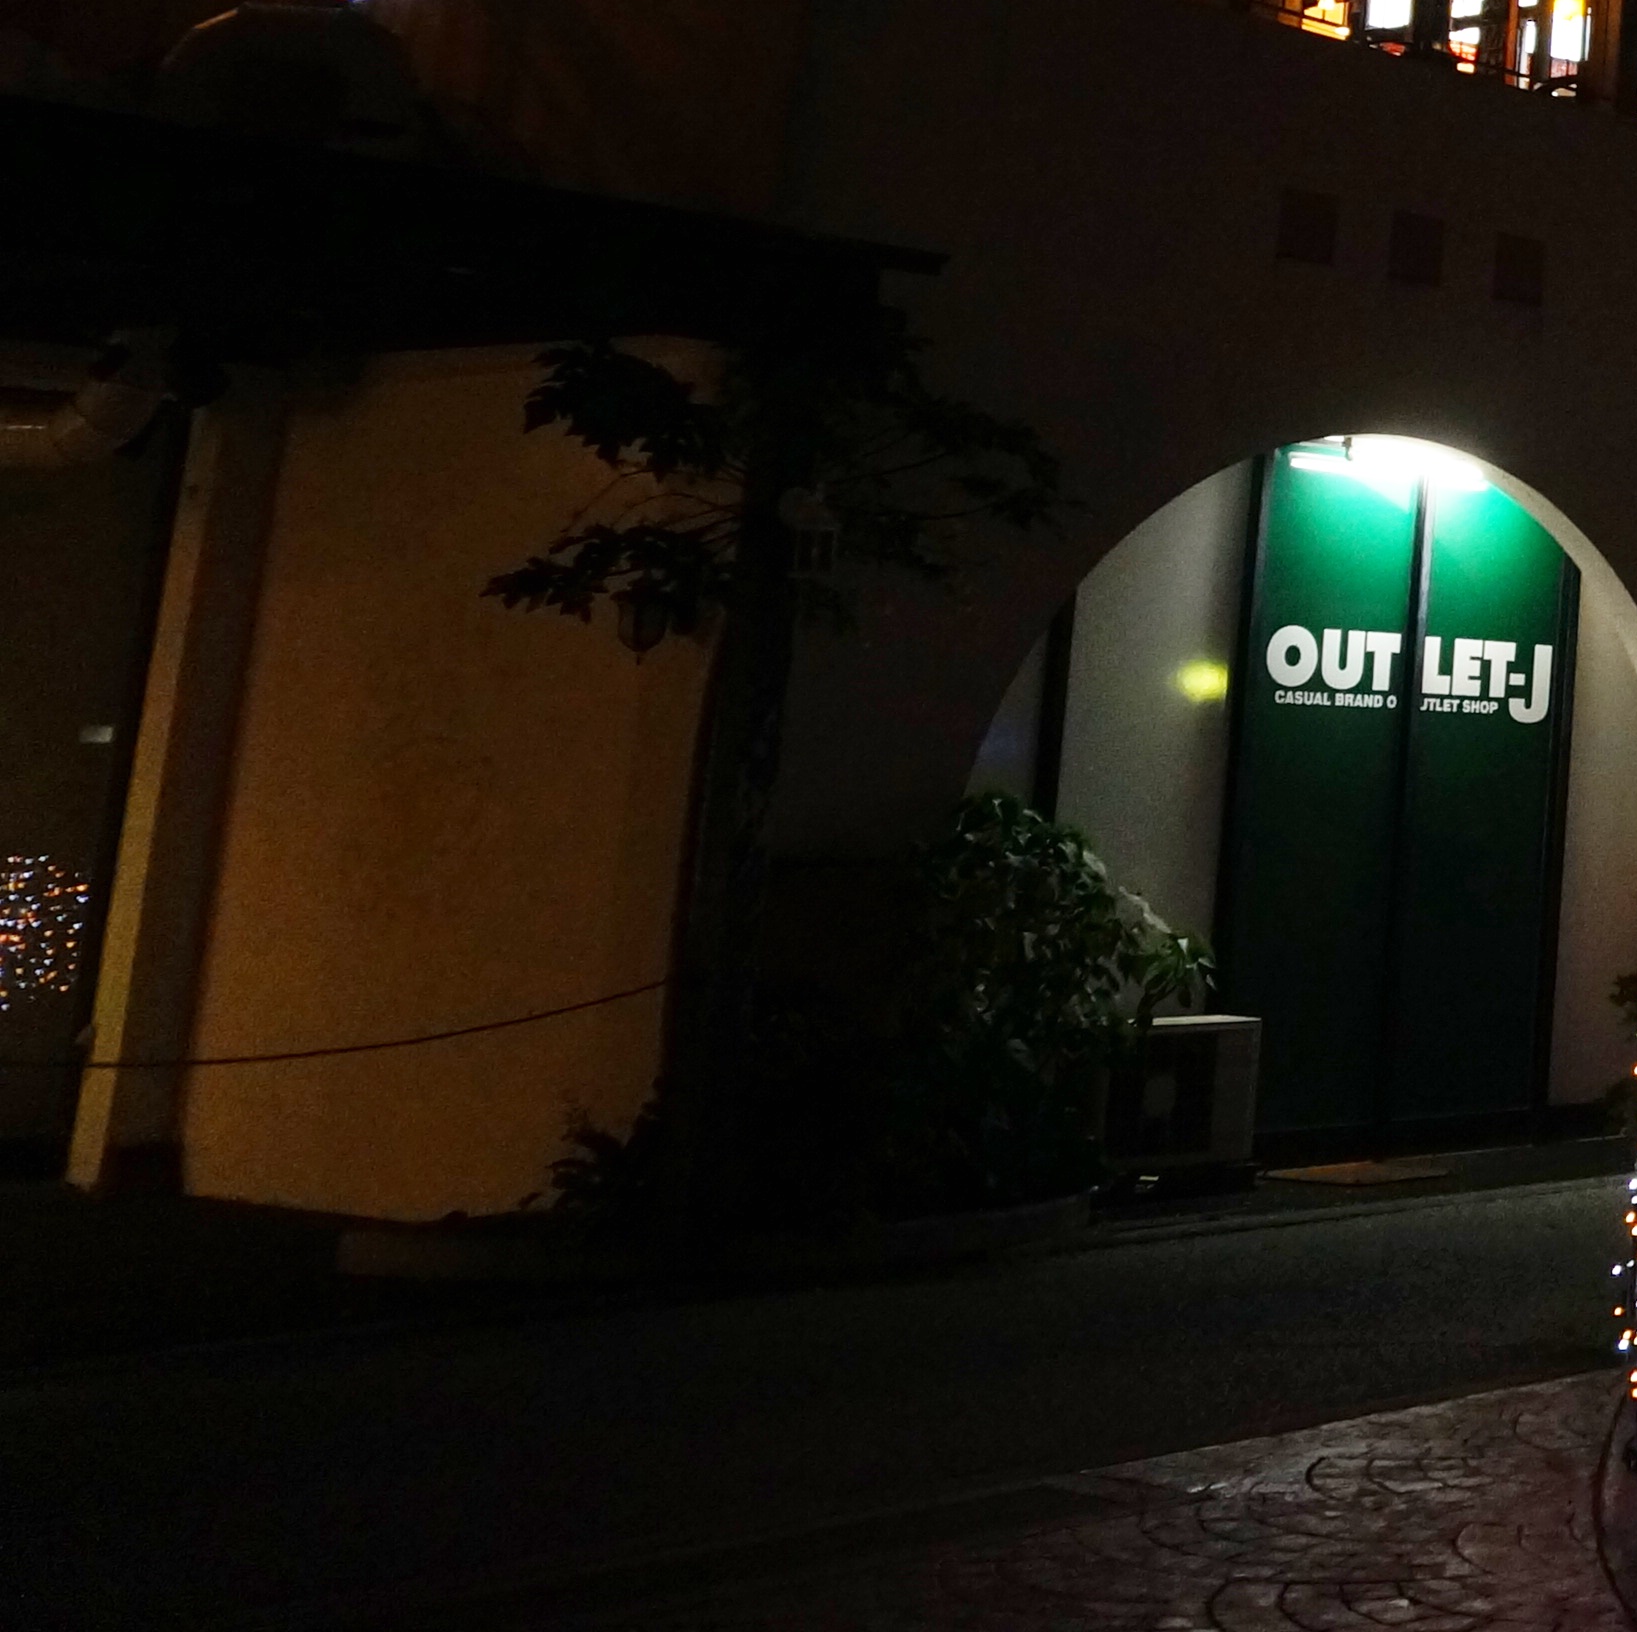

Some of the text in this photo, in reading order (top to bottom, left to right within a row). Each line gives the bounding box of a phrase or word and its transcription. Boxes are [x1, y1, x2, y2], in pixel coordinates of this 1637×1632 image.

[1275, 690, 1331, 706] CASUAL
[1335, 693, 1383, 708] BRAND
[1462, 700, 1499, 714] SHOP
